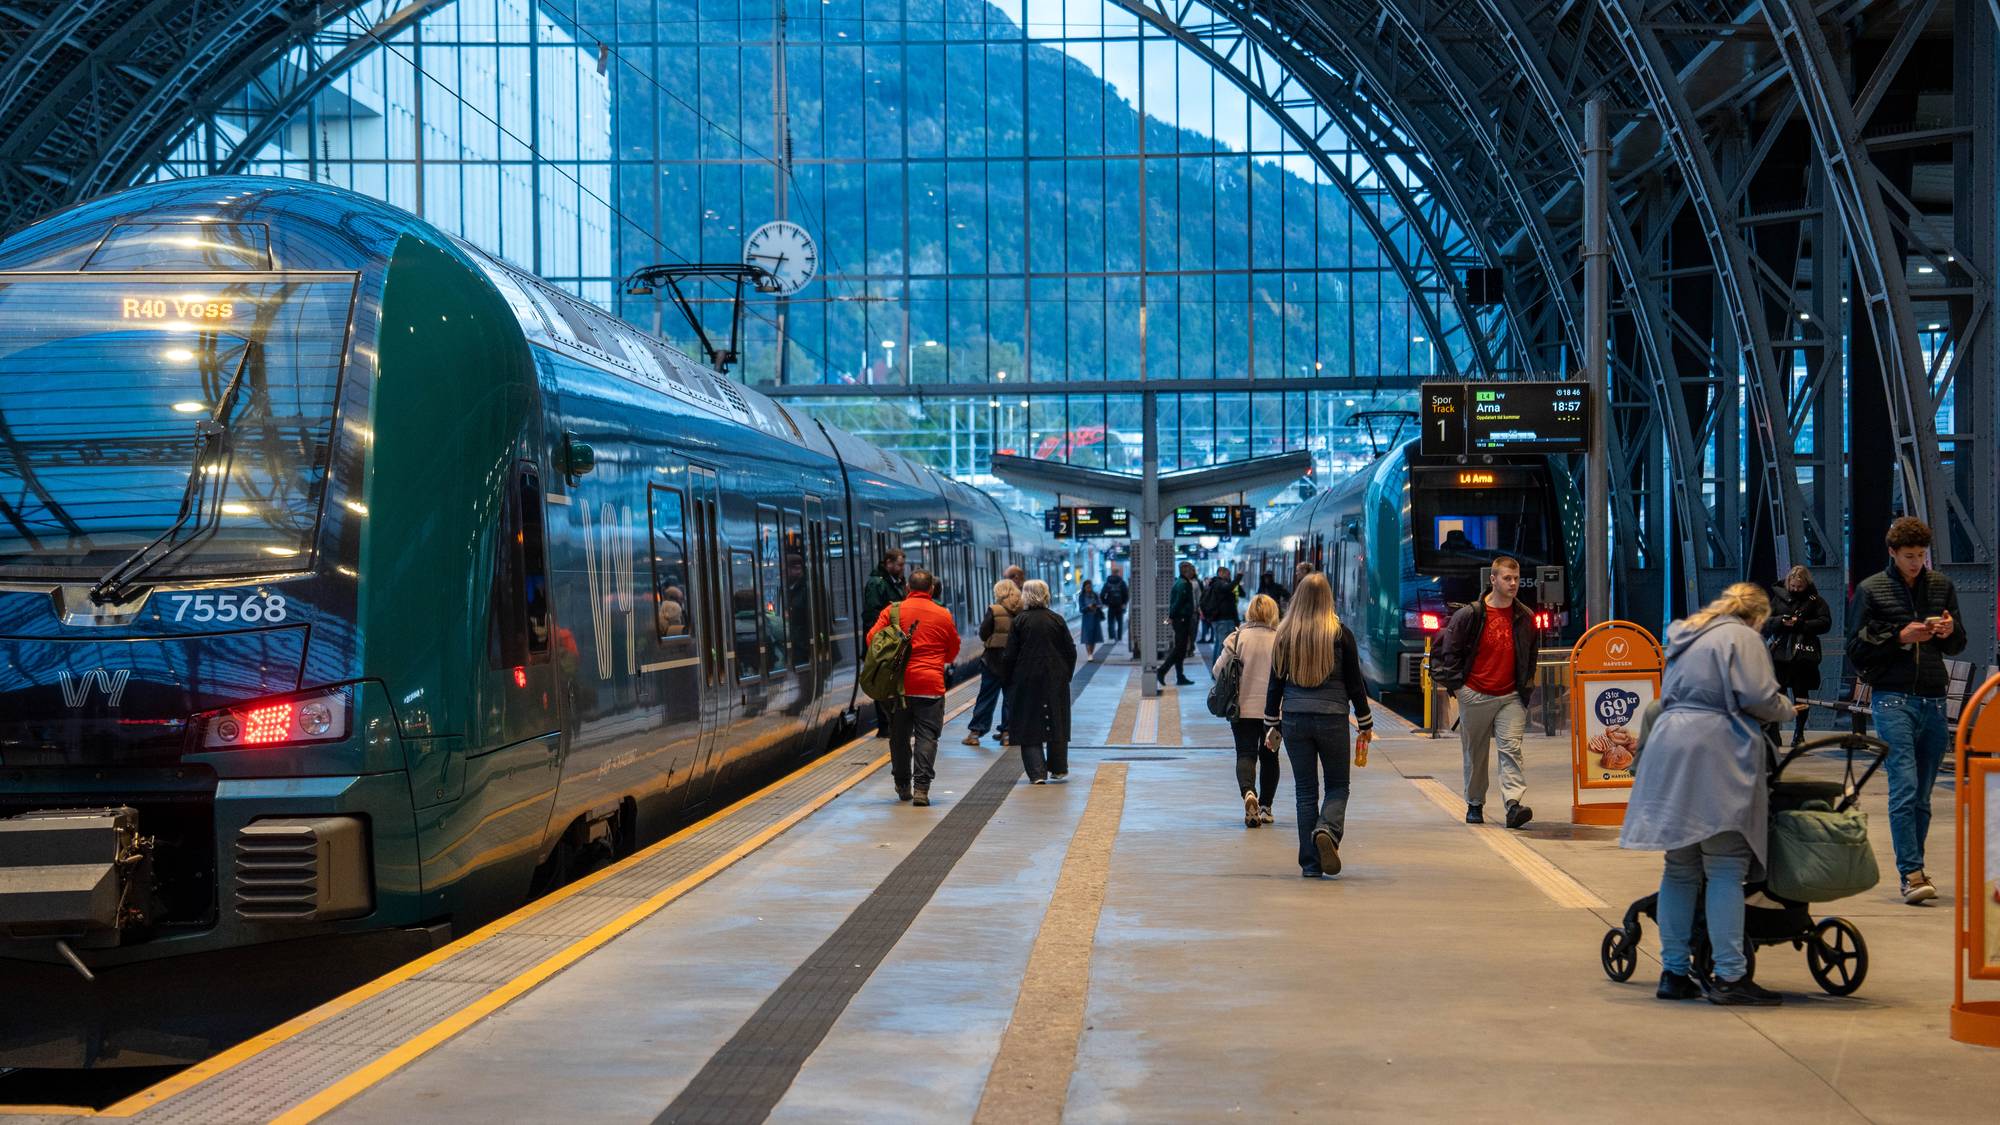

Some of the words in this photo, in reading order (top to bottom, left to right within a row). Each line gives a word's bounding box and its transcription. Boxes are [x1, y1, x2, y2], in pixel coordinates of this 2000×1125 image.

[123, 298, 167, 318] R40
[172, 299, 233, 318] Voss
[1432, 395, 1453, 406] Spor
[1432, 404, 1455, 413] Track
[1476, 403, 1501, 413] Arna
[1552, 401, 1581, 412] 18:57
[1437, 419, 1446, 442] 1
[1460, 473, 1471, 484] L4
[1472, 473, 1493, 484] Arna
[1059, 522, 1067, 534] 2
[1246, 517, 1252, 528] E
[171, 594, 287, 622] 75568
[57, 669, 131, 708] VY
[1605, 692, 1611, 700] 3
[1600, 698, 1628, 718] 69
